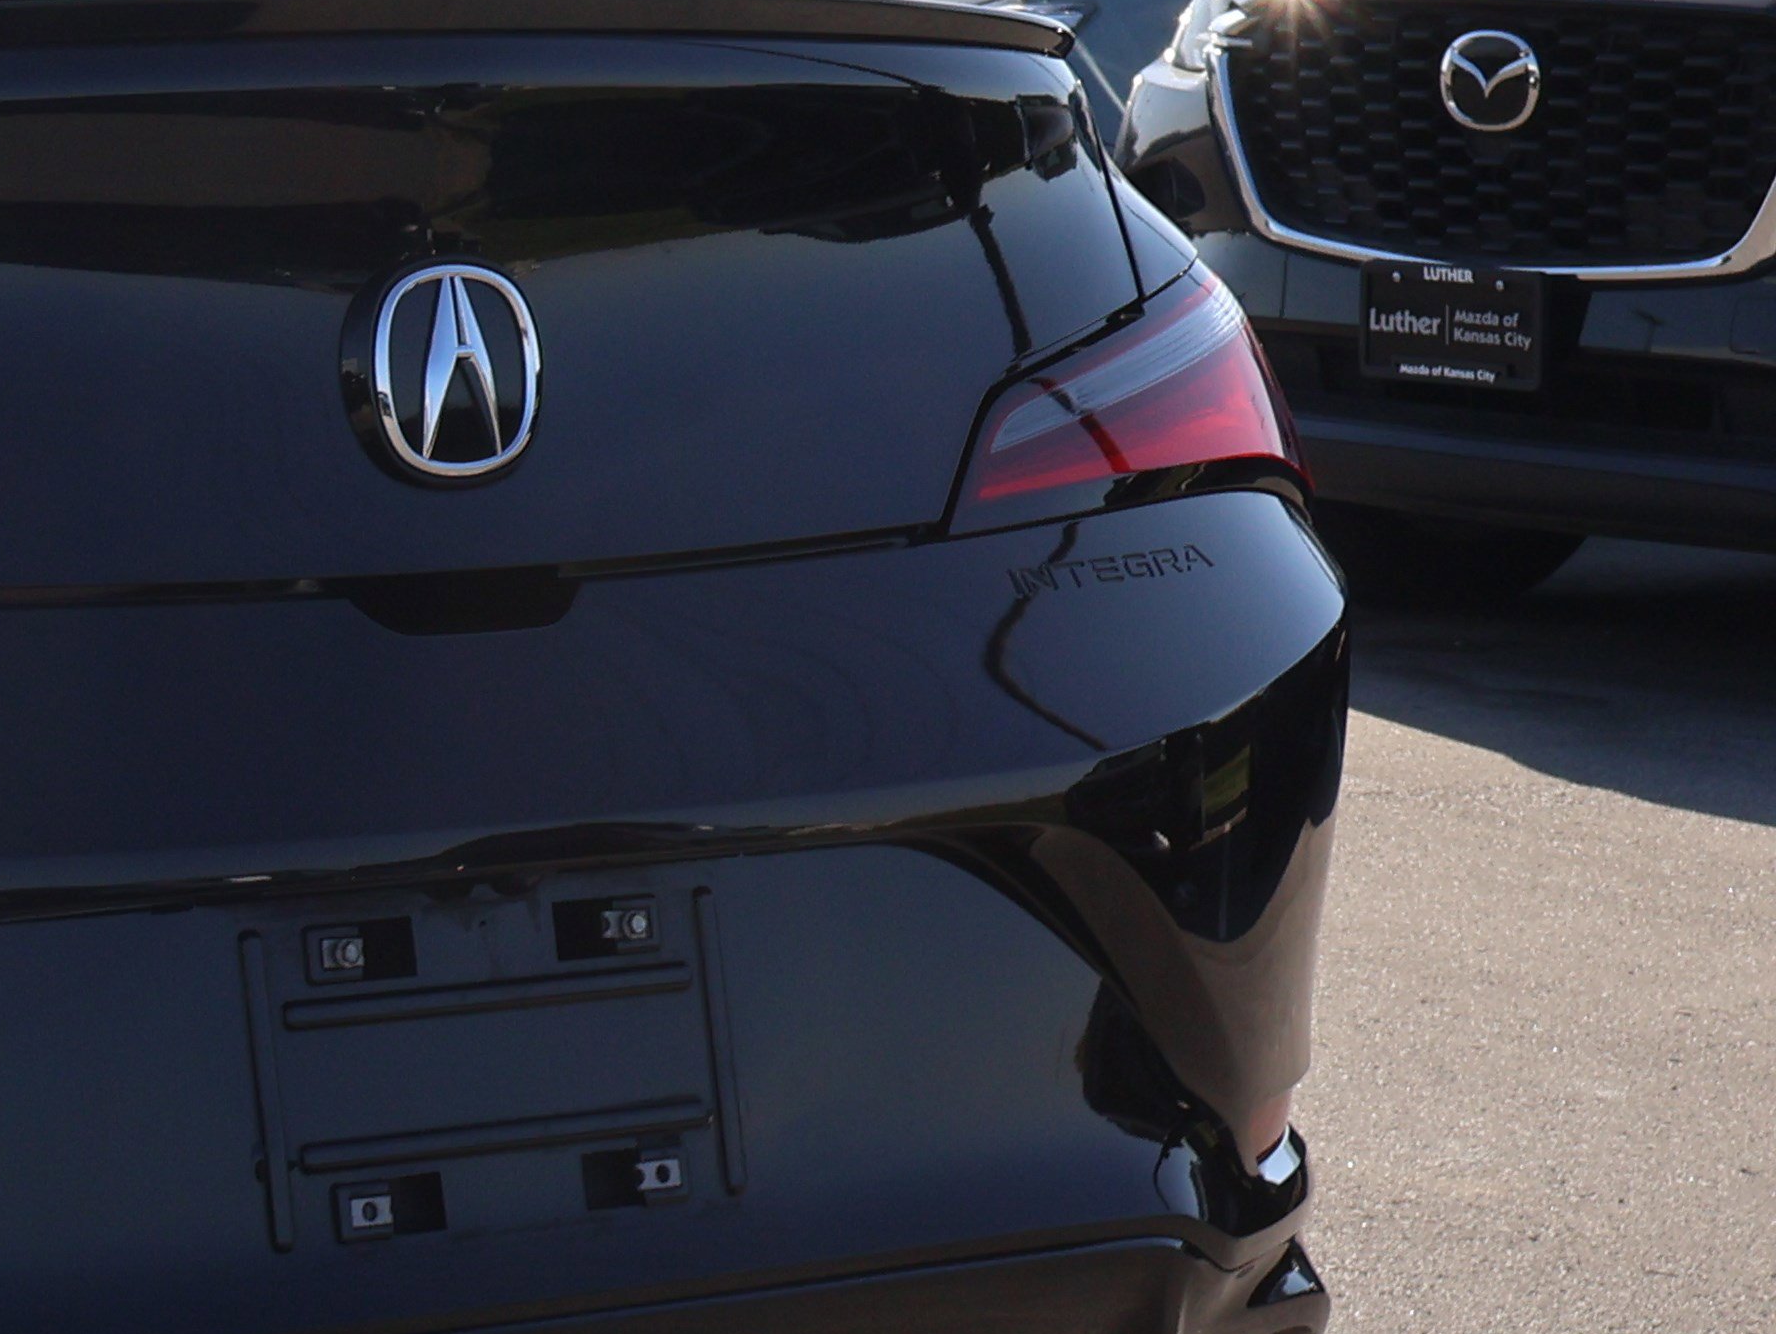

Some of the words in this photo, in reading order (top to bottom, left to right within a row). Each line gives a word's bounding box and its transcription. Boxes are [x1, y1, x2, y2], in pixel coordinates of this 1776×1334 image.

[1423, 266, 1474, 284] LUTHER
[1369, 307, 1441, 335] Luther
[1453, 309, 1499, 327] Mazda
[1503, 312, 1519, 327] of
[1453, 327, 1501, 345] Kansas
[1504, 331, 1532, 352] City
[1399, 363, 1430, 376] Mazda
[1431, 365, 1442, 377] of
[1443, 367, 1475, 380] Kansas
[1476, 368, 1495, 383] City
[1007, 543, 1216, 596] INTEGRA
